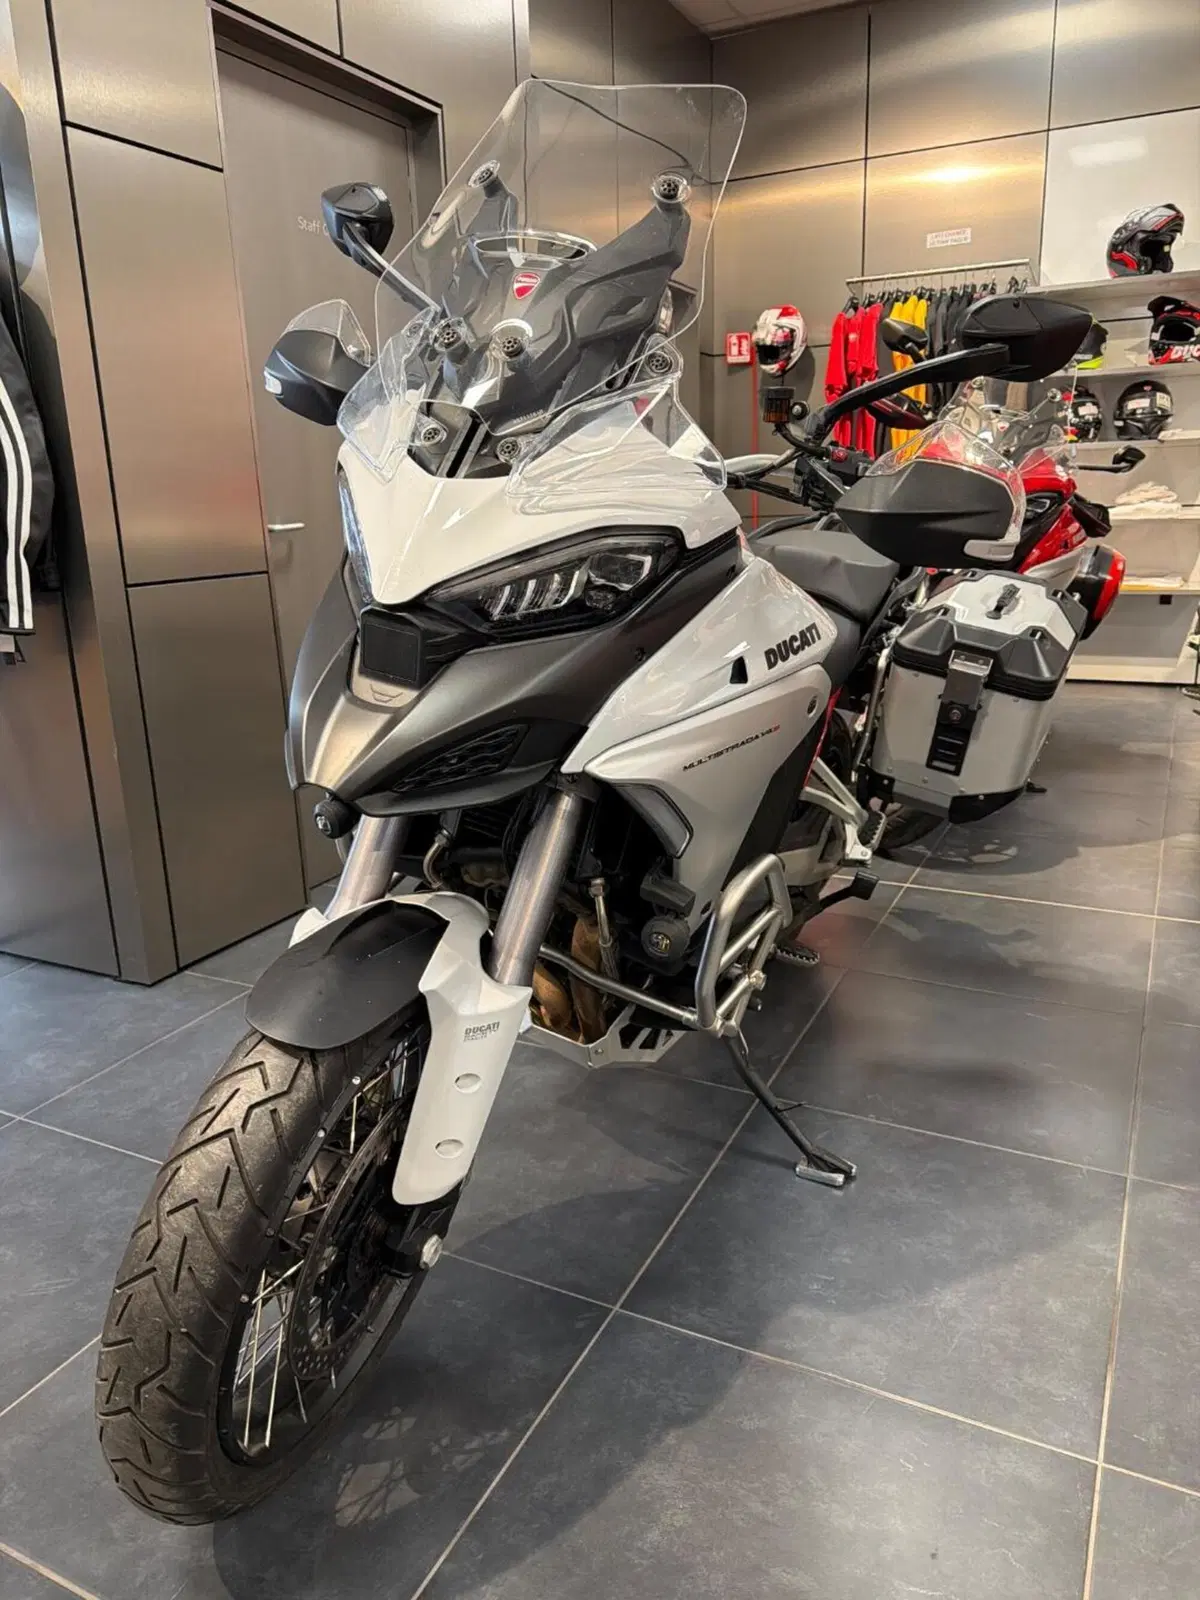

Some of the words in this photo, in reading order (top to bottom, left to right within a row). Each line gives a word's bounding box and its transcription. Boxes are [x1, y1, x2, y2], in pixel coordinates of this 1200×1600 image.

[297, 216, 320, 235] Staff
[764, 622, 821, 670] DUCATI
[682, 734, 759, 771] MULTISTRADA
[464, 1021, 500, 1035] DUCATI
